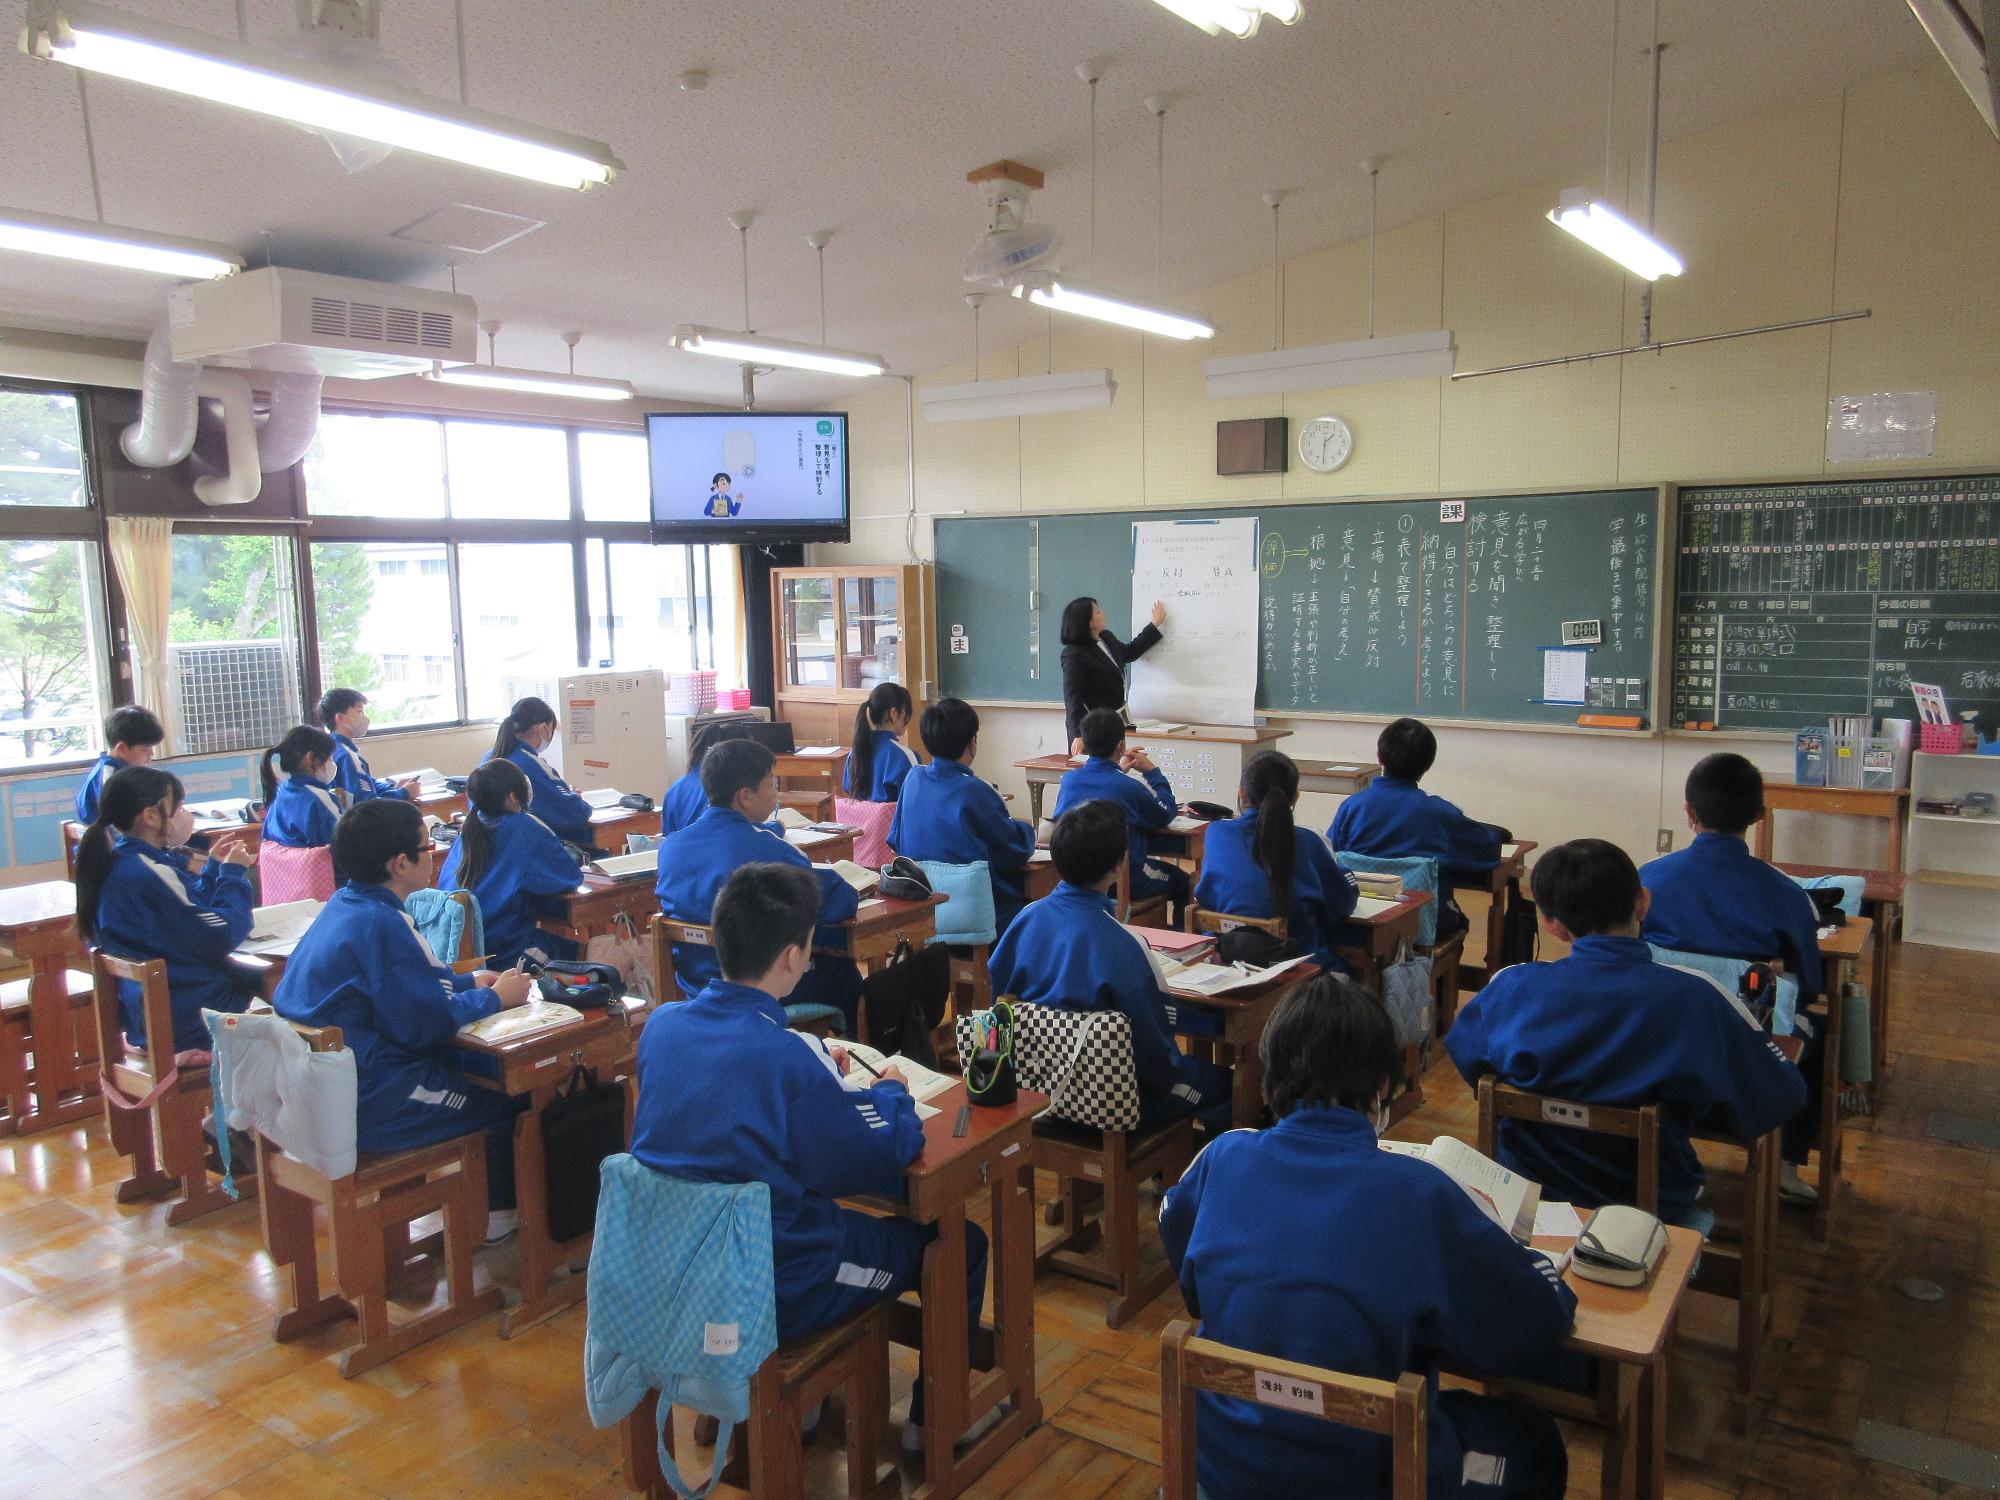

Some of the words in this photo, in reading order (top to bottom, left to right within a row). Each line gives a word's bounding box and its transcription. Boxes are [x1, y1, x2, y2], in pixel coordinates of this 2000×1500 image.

[1442, 504, 1464, 519] 課
[1263, 540, 1279, 573] 評価
[1467, 511, 1488, 593] 検討する
[1529, 519, 1548, 582] 四月二十五日
[1441, 543, 1460, 697] 自分はどちらの意見に
[953, 638, 966, 651] ま
[1691, 627, 1716, 638] 数学
[1691, 643, 1716, 655] 社会
